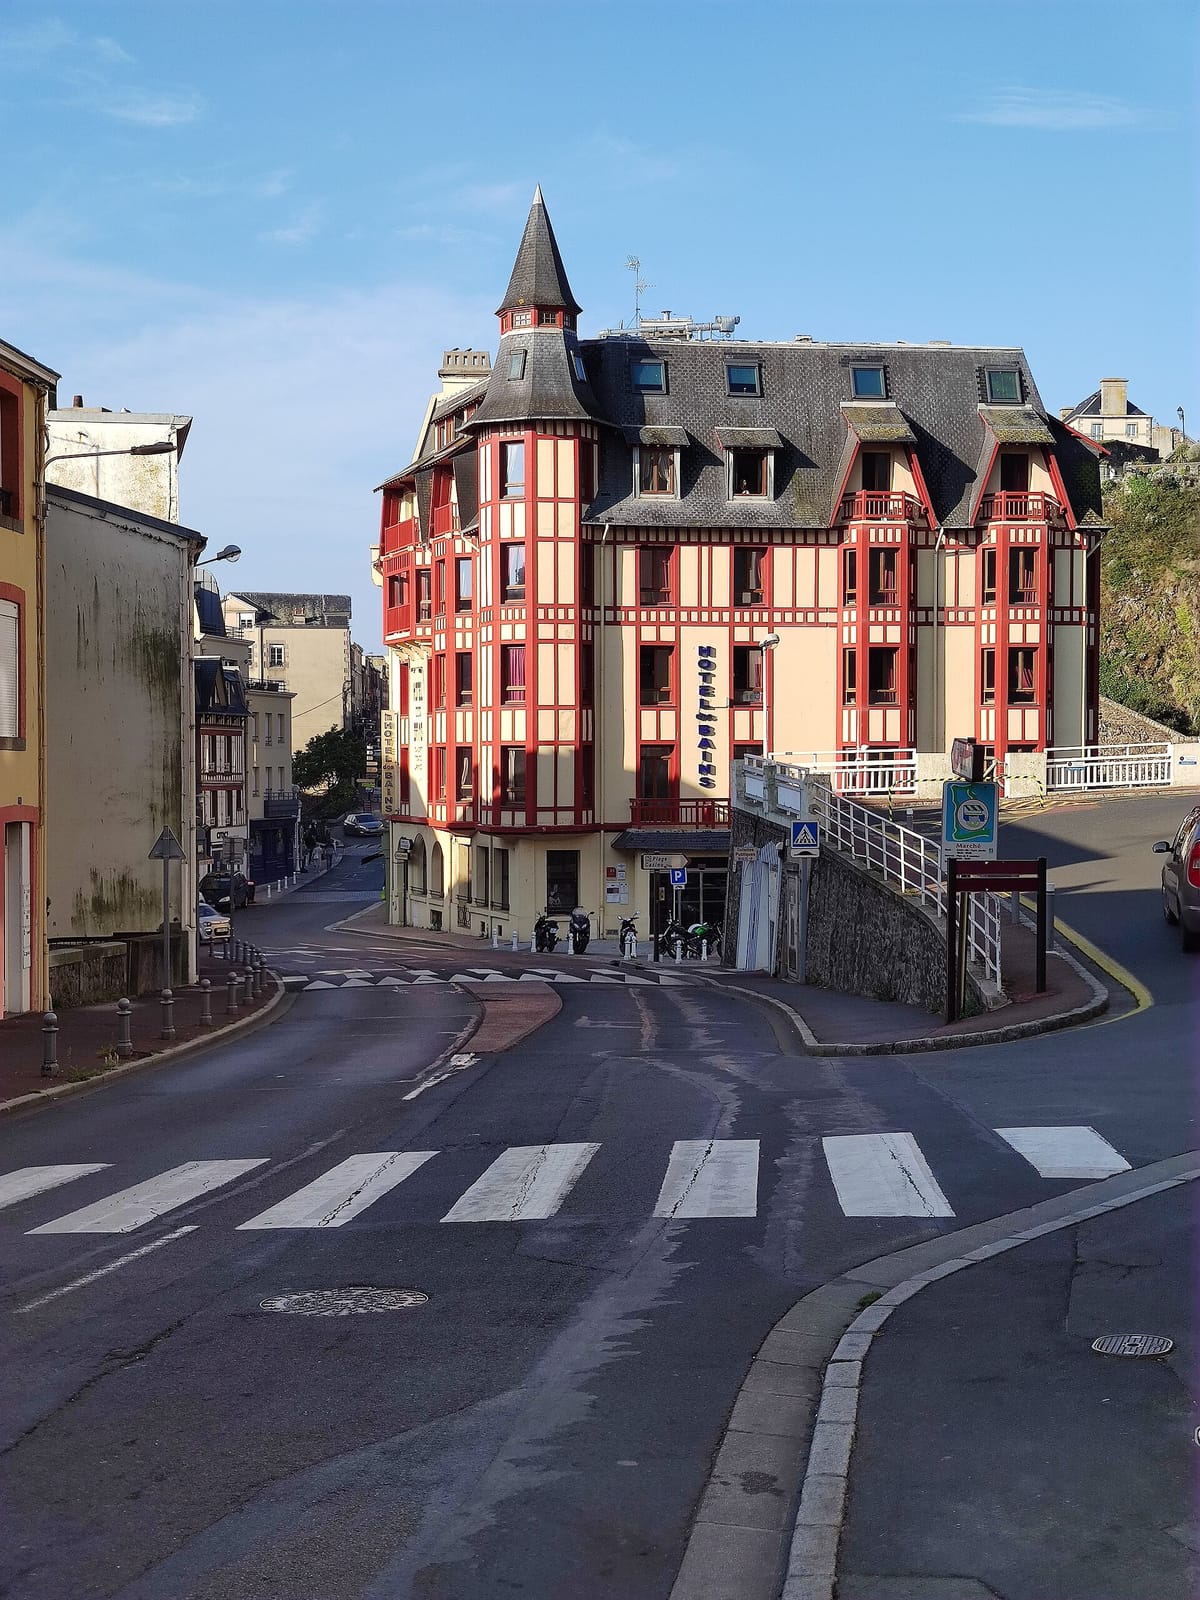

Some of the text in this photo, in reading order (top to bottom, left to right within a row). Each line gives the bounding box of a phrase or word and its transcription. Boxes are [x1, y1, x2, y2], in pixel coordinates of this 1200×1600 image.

[698, 645, 717, 710] HOTEL
[697, 724, 717, 789] BAINS
[384, 771, 393, 812] BAINS
[674, 870, 682, 882] P
